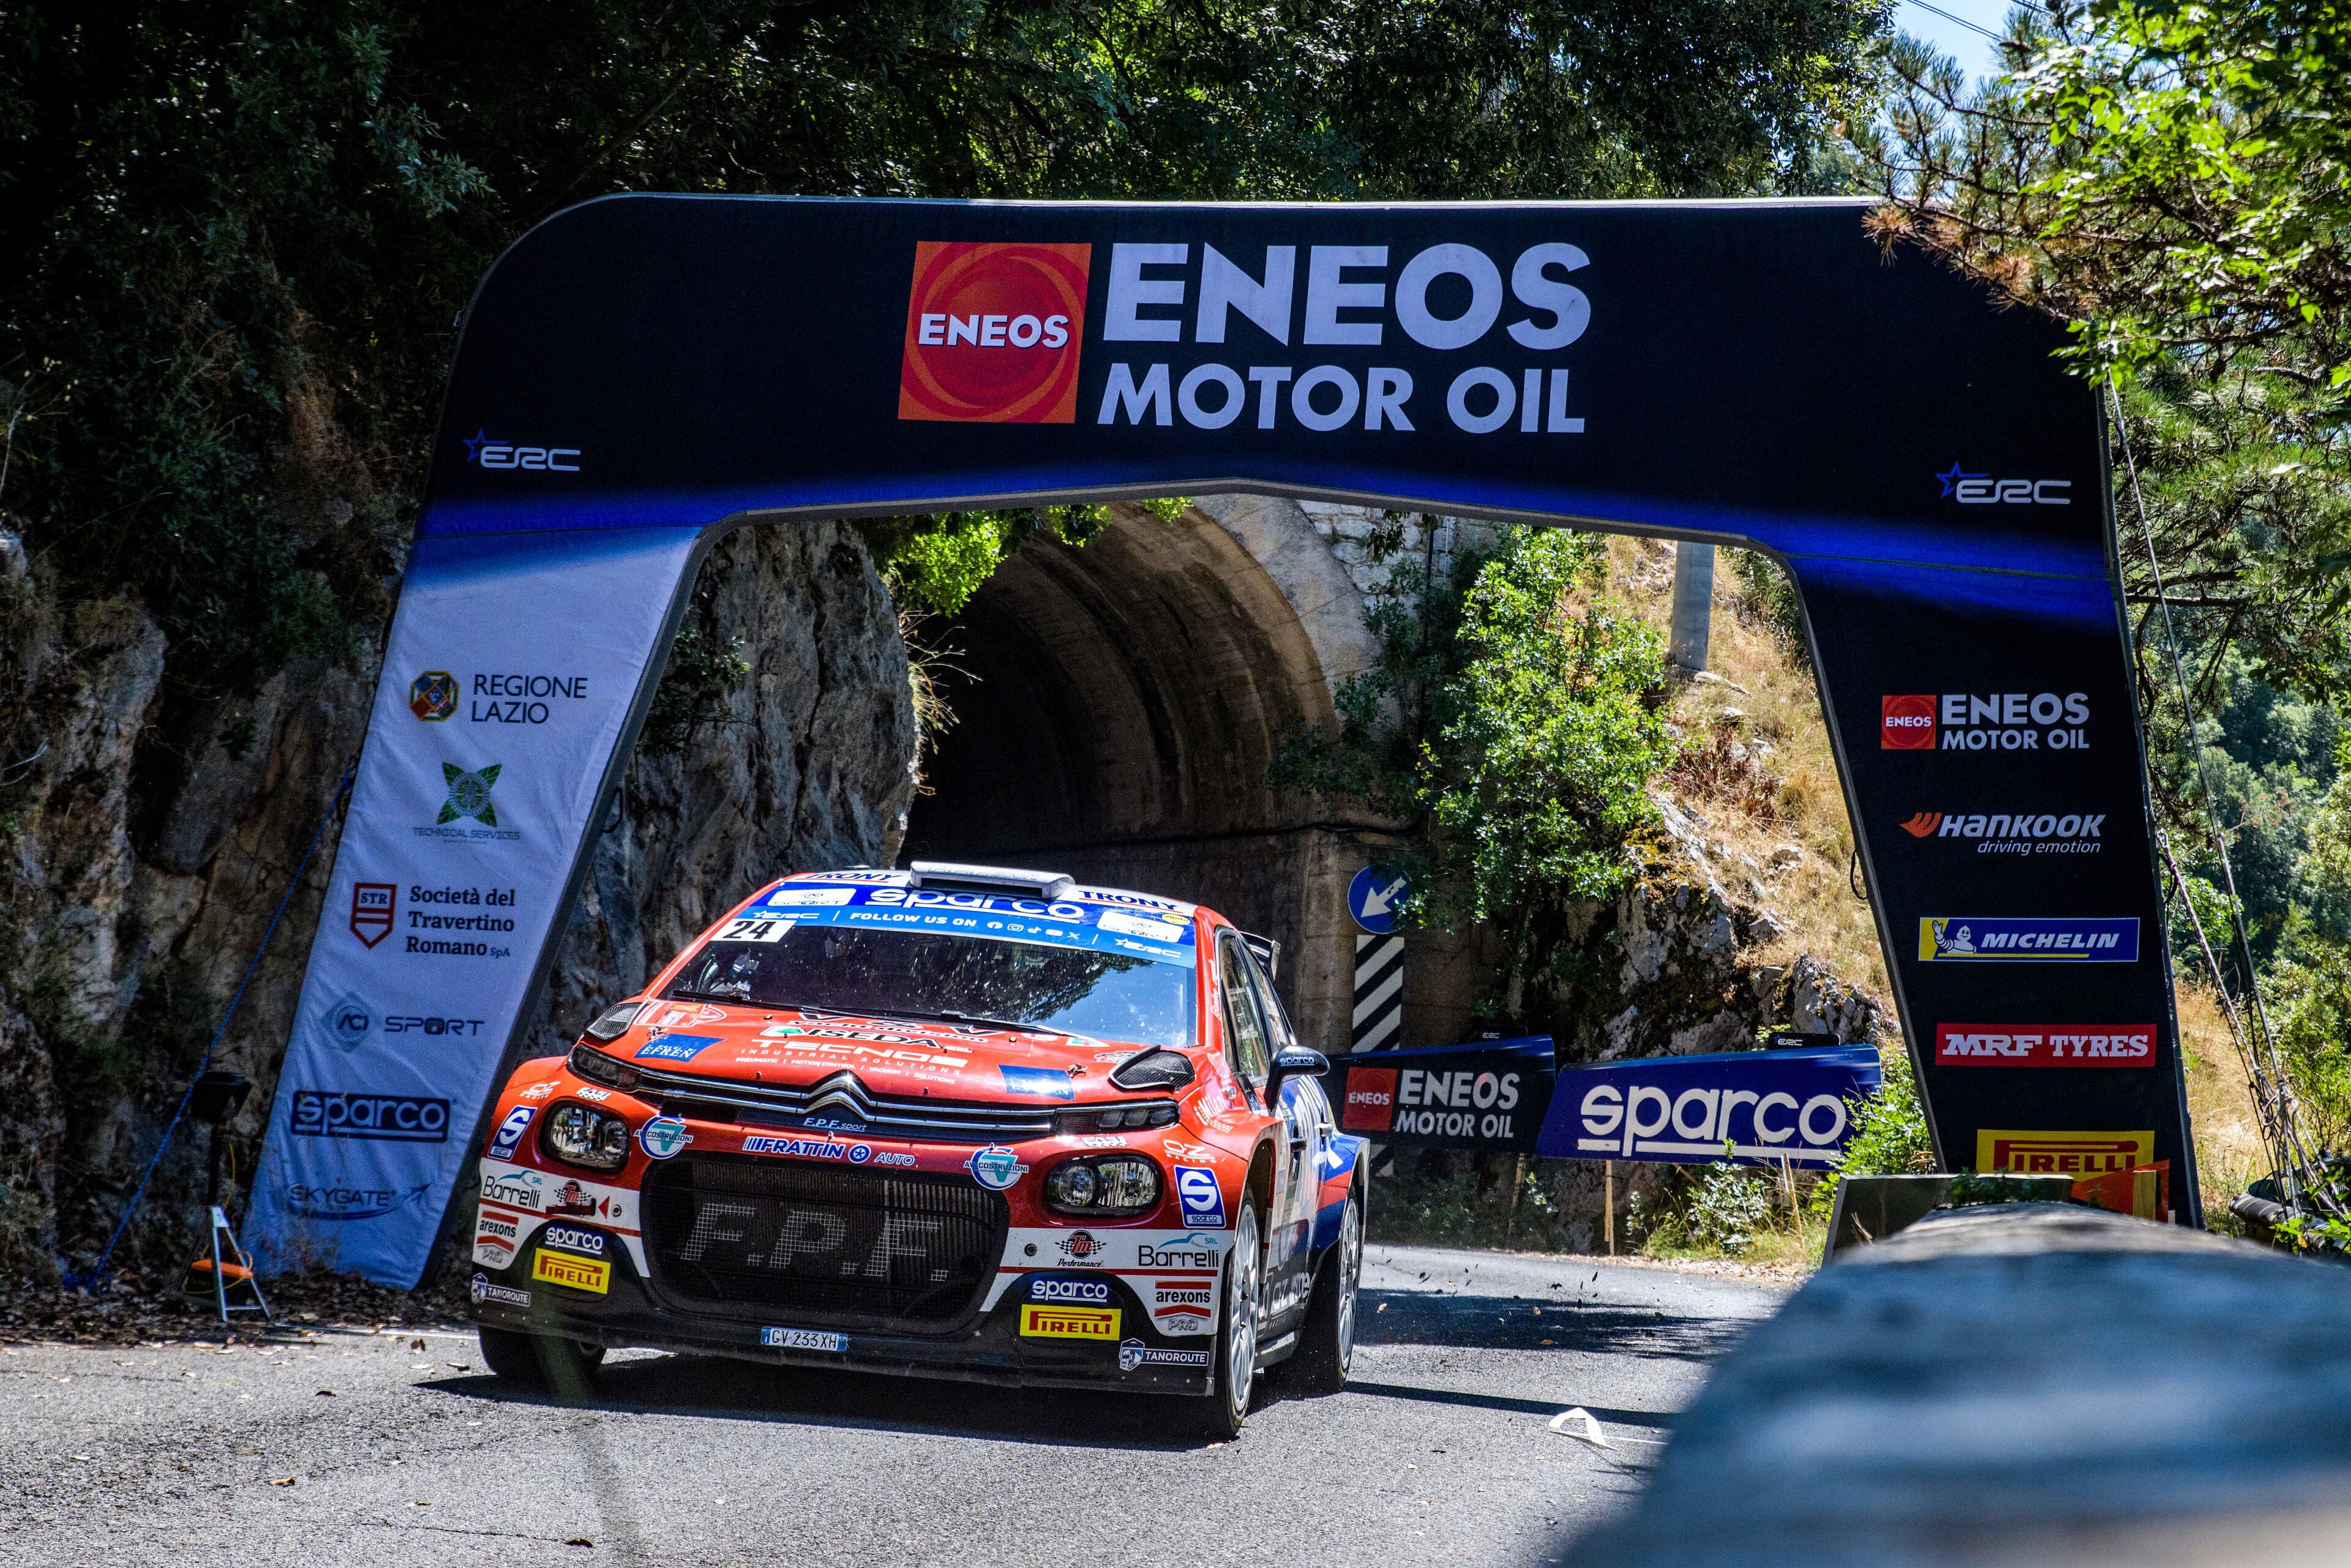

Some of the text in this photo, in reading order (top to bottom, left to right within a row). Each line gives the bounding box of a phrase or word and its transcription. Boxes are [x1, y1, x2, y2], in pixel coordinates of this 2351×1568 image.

[1103, 242, 1592, 350] ENEOS
[918, 313, 1069, 349] ENEOS
[1097, 362, 1586, 433] MOTOR OIL
[481, 446, 581, 471] ERC
[1957, 479, 2071, 505] ERC
[473, 674, 588, 699] REGIONE
[471, 702, 549, 724] LAZIO
[1941, 692, 2090, 725] ENEOS
[1886, 716, 1932, 727] ENEOS
[1941, 729, 2090, 749] MOTOR OIL
[414, 827, 520, 840] TECHNICAL SERVICES
[1978, 841, 2101, 856] driving emotion
[360, 892, 388, 905] STR
[410, 886, 515, 907] Società del
[865, 888, 1085, 924] sparco
[1079, 890, 1179, 910] TRONY
[409, 912, 514, 932] Travertino
[850, 912, 977, 927] FOLLOW US ON
[722, 920, 776, 940] 24
[405, 936, 510, 958] Romano SpA
[1981, 933, 2120, 948] MICHELIN
[384, 1016, 484, 1036] SPORT
[640, 1047, 694, 1059] EFREN
[1942, 1033, 2148, 1057] MRF TYRES
[741, 1049, 961, 1076] INDUSTRIAL SOLUTIONS
[1280, 1057, 1314, 1067] sparco
[914, 1073, 955, 1084] SOLUTIONS
[1349, 1092, 1390, 1106] ENEOS
[1399, 1070, 1520, 1110] ENEOS
[295, 1095, 446, 1136] sparco
[1396, 1111, 1514, 1138] MOTOR OIL
[1578, 1085, 1848, 1159] sparco
[647, 1131, 692, 1142] COSTRUZIONI
[761, 1138, 915, 1166] FRATTIN AUTO
[1166, 1154, 1217, 1163] RACING
[1993, 1139, 2139, 1172] PIRELLI
[978, 1163, 1028, 1172] COSTRUZIONI
[532, 1177, 542, 1185] SRL
[290, 1184, 391, 1207] SKYGATE
[1191, 1214, 1218, 1223] sparco
[479, 1220, 516, 1238] arexons
[546, 1227, 603, 1255] sparco
[680, 1202, 950, 1282] F.P.F.
[539, 1255, 603, 1288] PIRELLI
[1058, 1258, 1103, 1267] Performance
[489, 1288, 528, 1304] TANOROUTE
[1032, 1280, 1108, 1302] sparco
[1157, 1289, 1210, 1304] arexons
[1029, 1310, 1112, 1335] PIRELLI
[1168, 1319, 1198, 1330] PRO
[771, 1330, 788, 1345] GV
[1146, 1351, 1205, 1364] TANOROUTE
